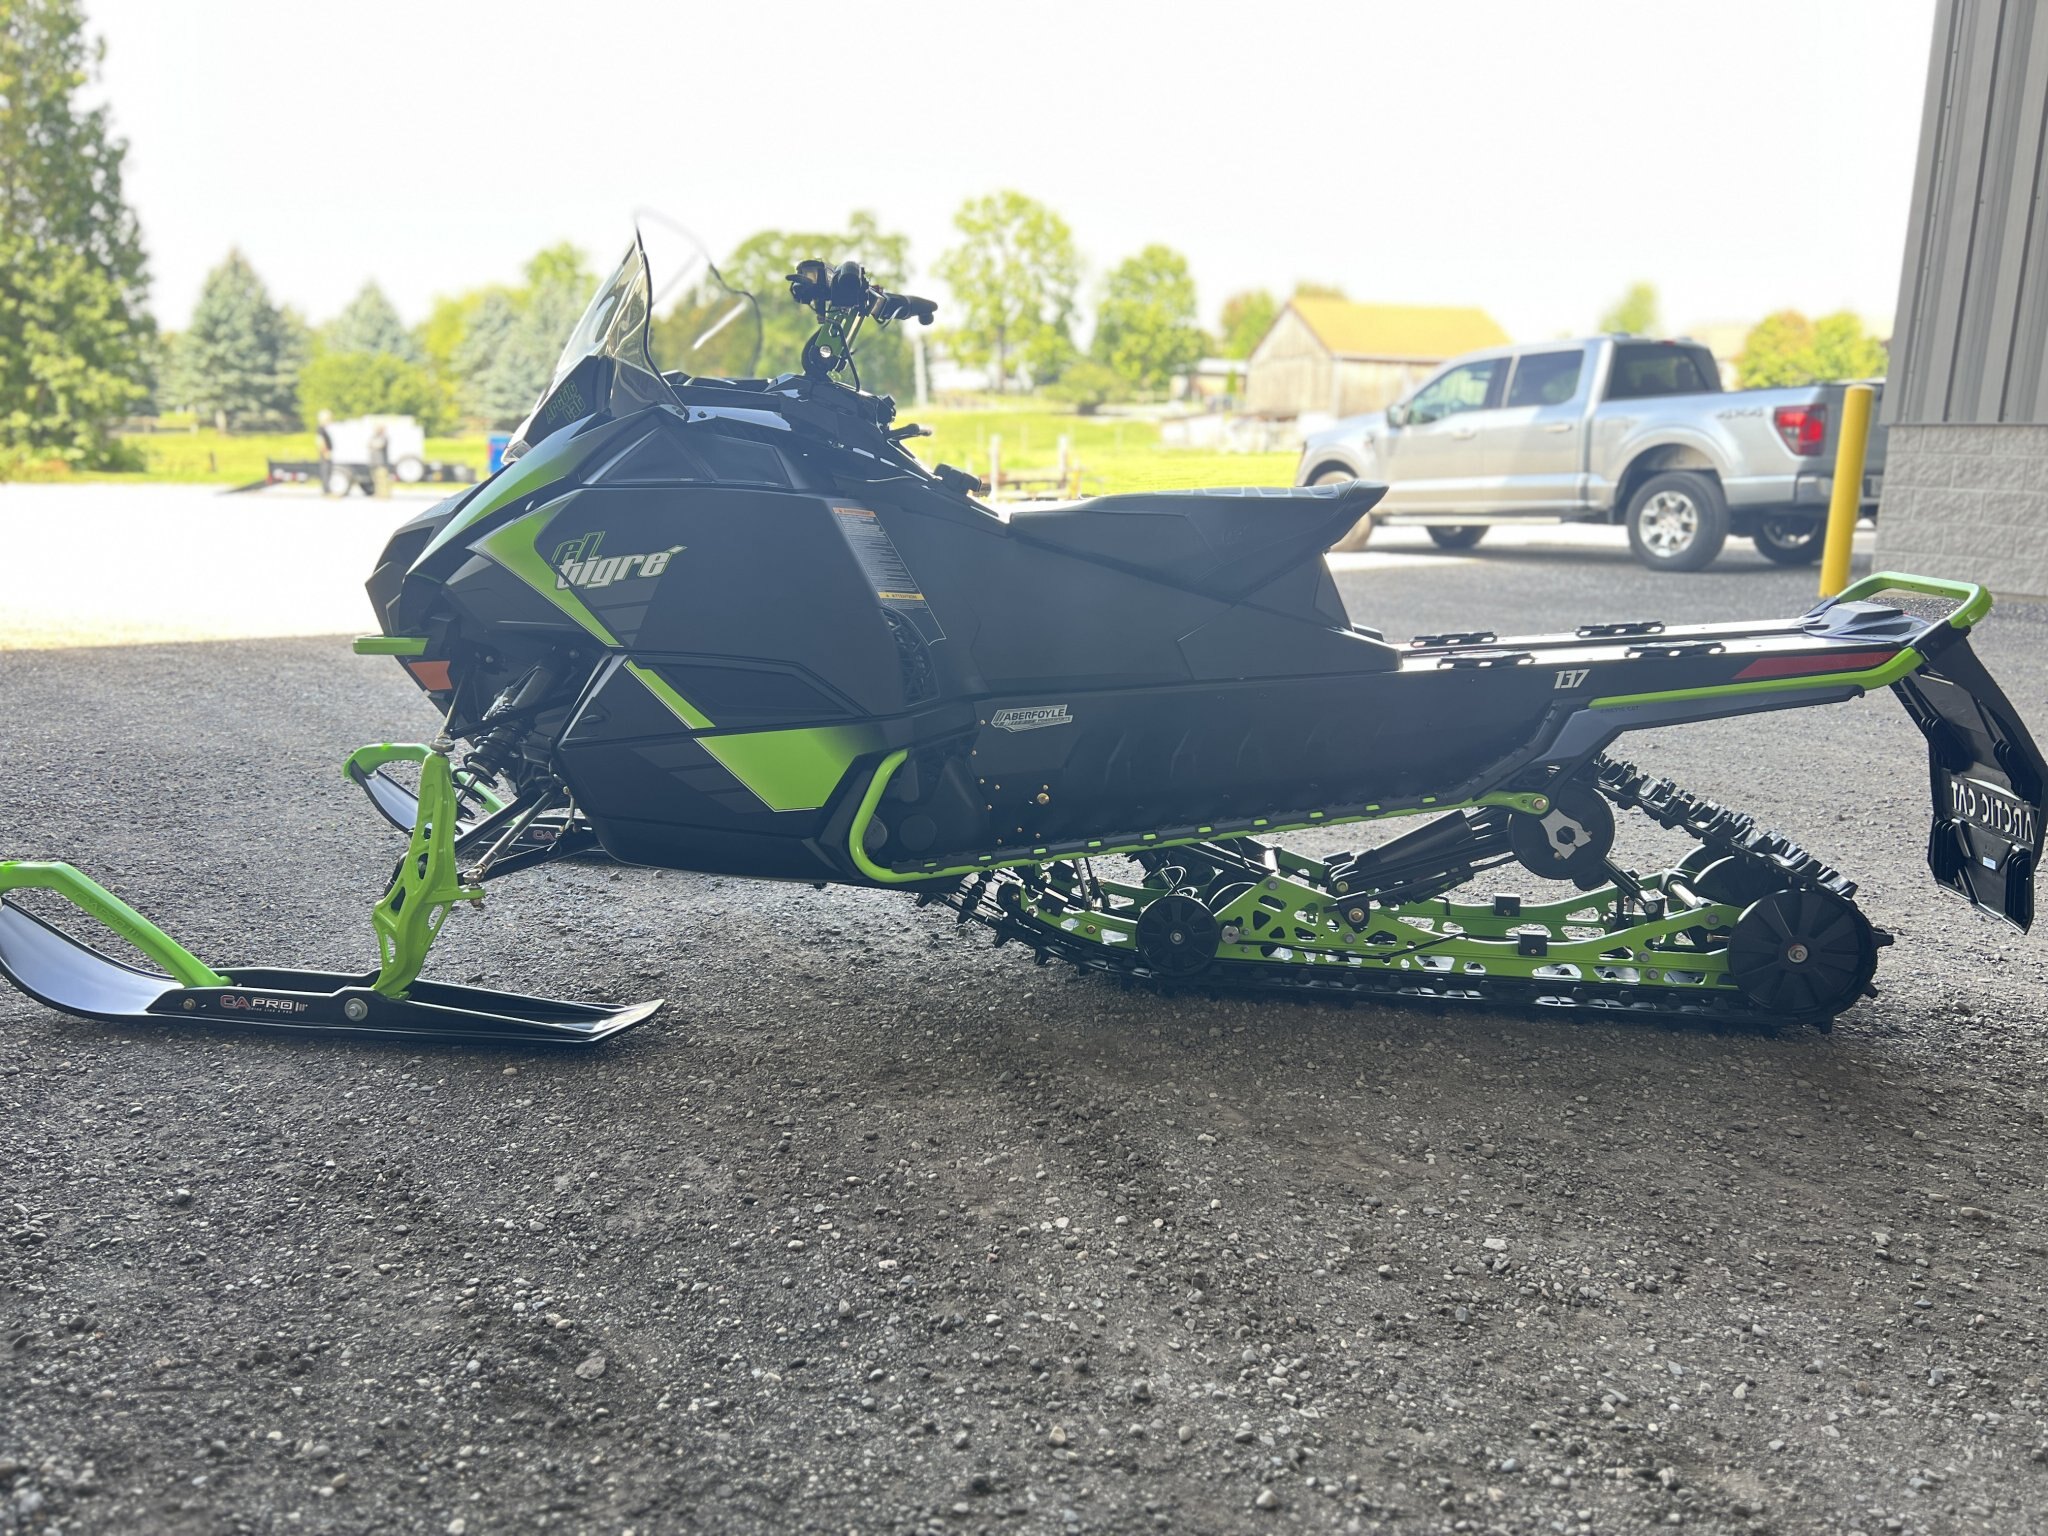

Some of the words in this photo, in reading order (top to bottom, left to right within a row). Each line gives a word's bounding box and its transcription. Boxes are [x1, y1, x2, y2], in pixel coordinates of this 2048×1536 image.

[544, 380, 578, 425] Arctic
[1553, 669, 1591, 689] 137
[1003, 708, 1065, 722] ABERFOYLE
